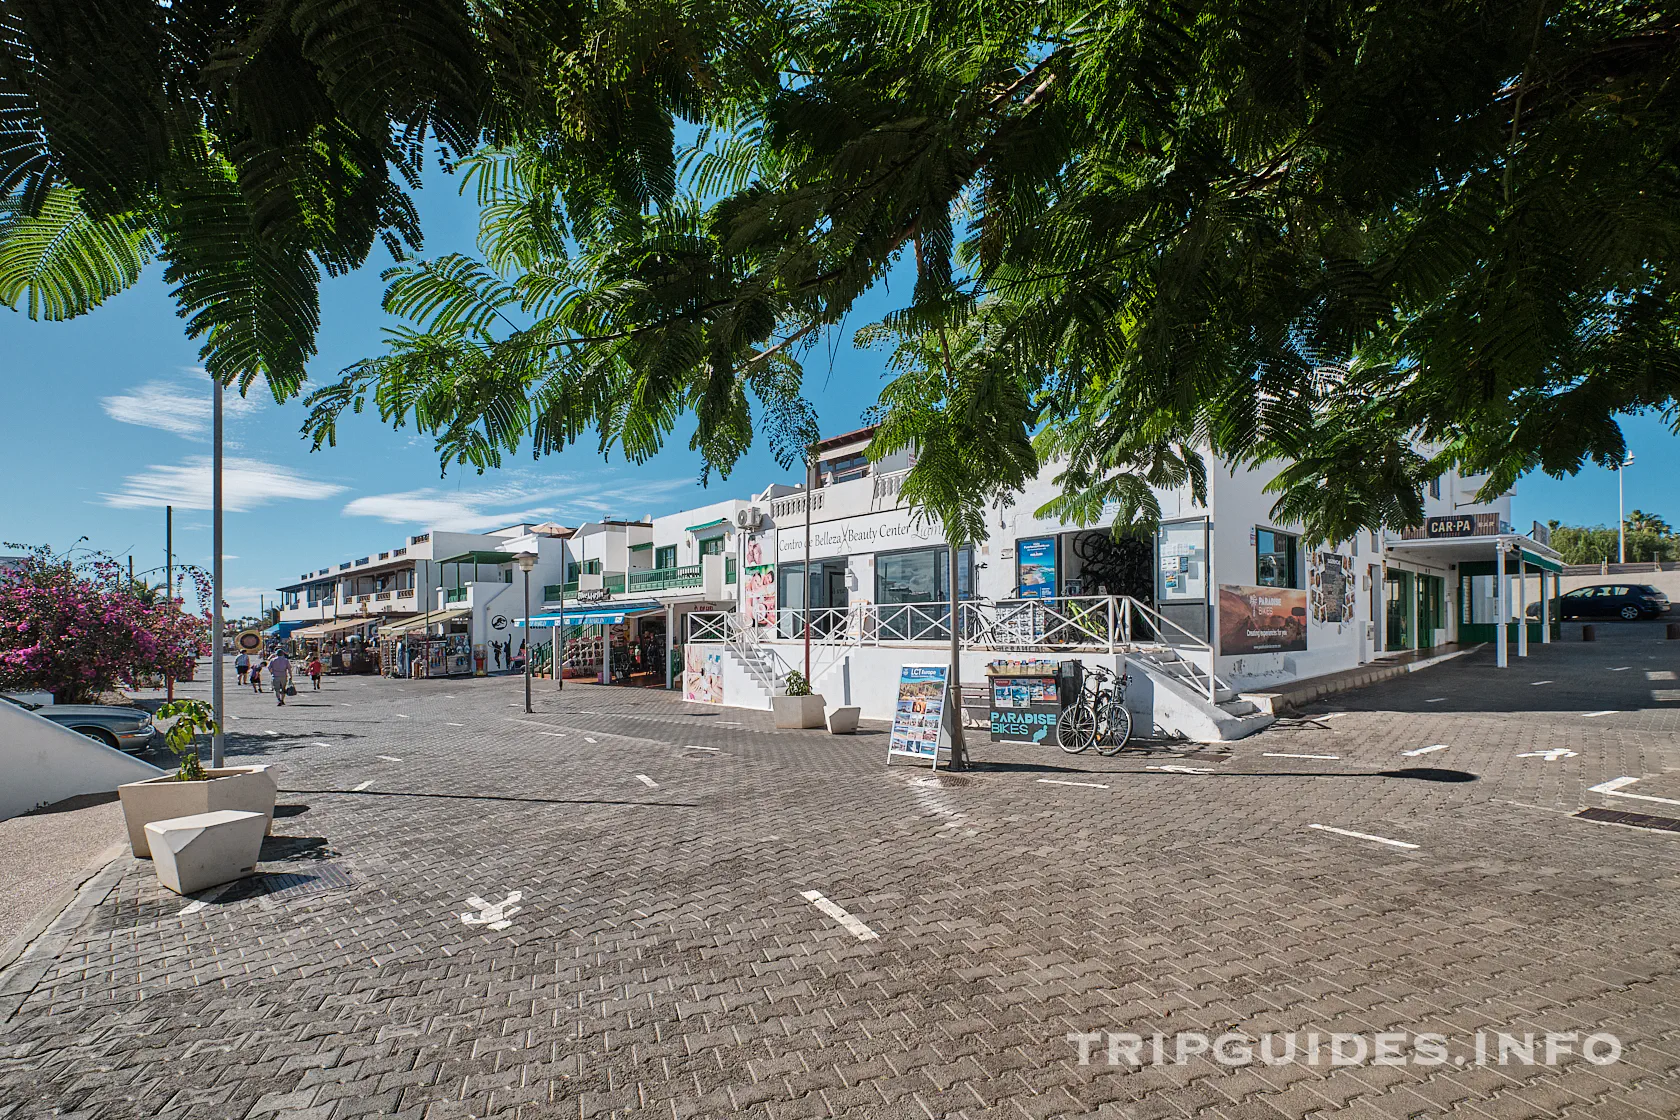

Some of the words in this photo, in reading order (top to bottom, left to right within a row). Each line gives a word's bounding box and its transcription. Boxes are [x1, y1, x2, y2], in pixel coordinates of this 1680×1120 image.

[848, 527, 877, 543] Beauty
[879, 523, 910, 538] Center
[779, 539, 803, 551] Centro
[815, 532, 842, 547] Belleza
[1259, 597, 1281, 606] PARADISE
[911, 668, 922, 676] LCT
[991, 712, 1057, 725] PARADISE
[992, 723, 1029, 735] BIKES
